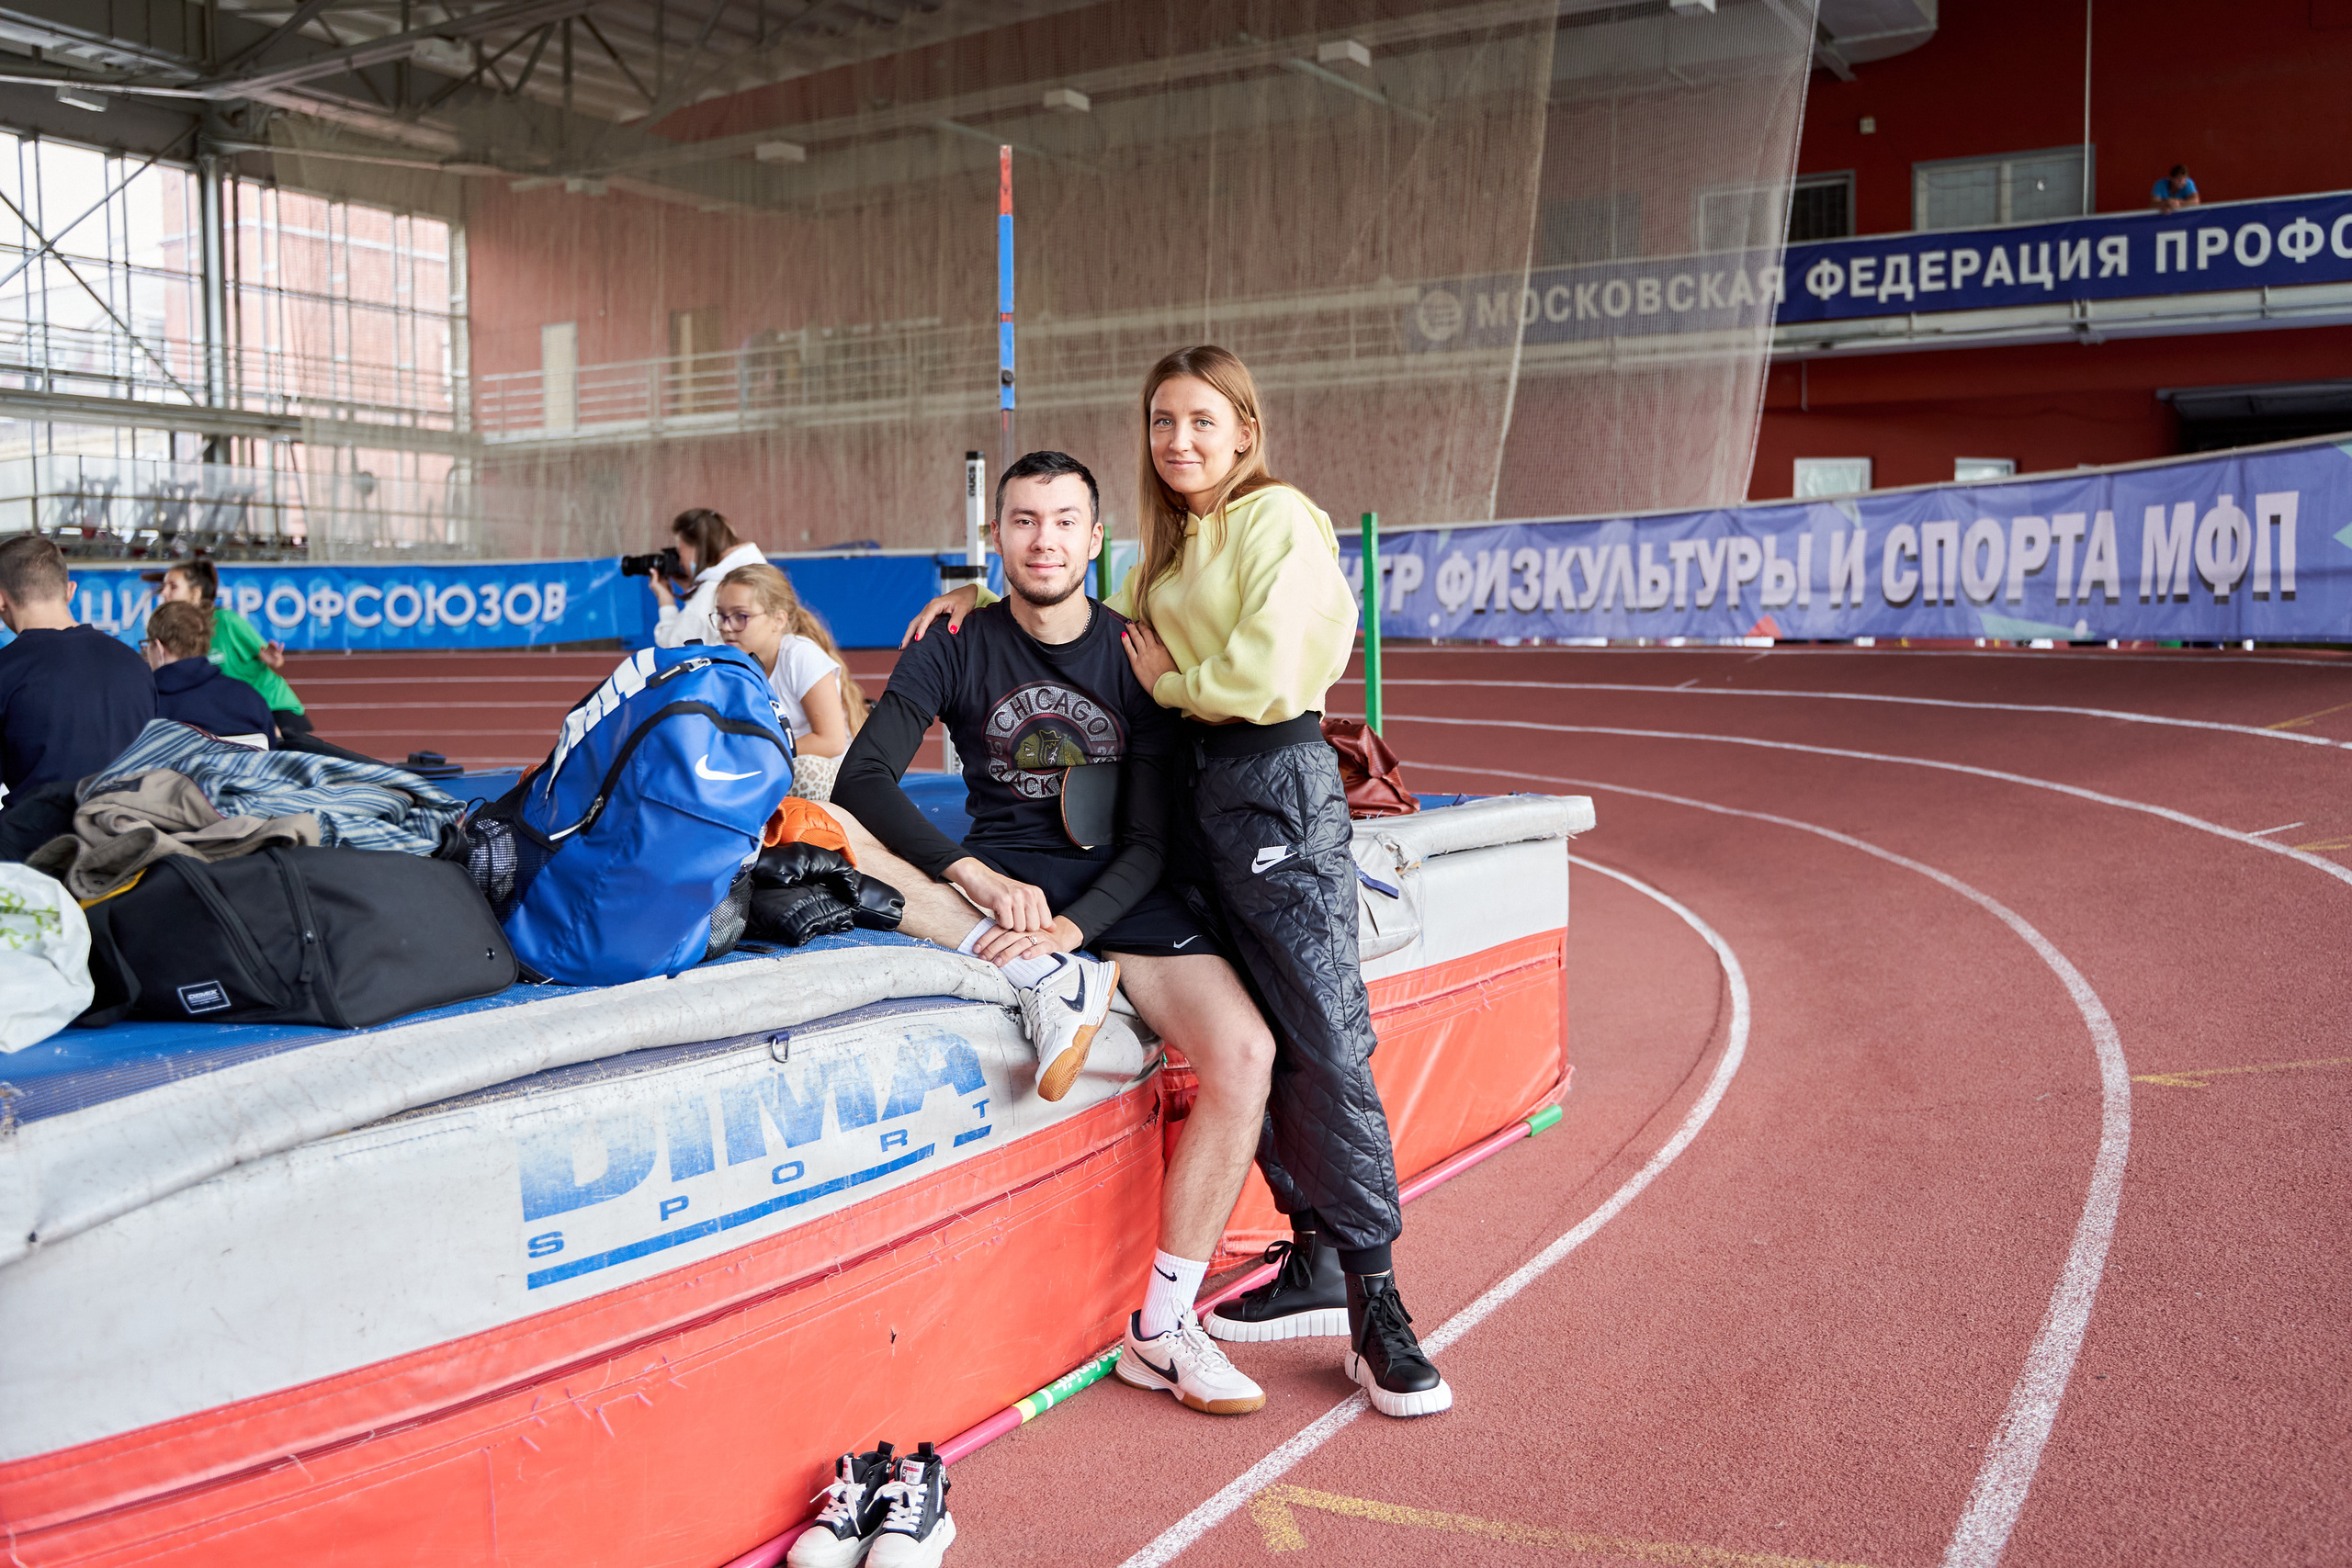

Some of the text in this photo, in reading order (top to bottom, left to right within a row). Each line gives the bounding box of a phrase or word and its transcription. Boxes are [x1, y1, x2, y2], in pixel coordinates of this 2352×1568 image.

[1476, 265, 1787, 328] МОСКОВСКАЯ
[1805, 234, 2129, 303] ФЕДЕРАЦИЯ
[1435, 532, 1813, 615] ФИЗКУЛЬТУРЫ
[1828, 528, 1868, 609] И
[1882, 510, 2121, 607] СПОРТА
[2139, 491, 2299, 604] МФП
[988, 739, 1003, 756] 19
[994, 688, 1109, 735] CHICAGO
[990, 764, 1063, 796] BLACK
[516, 1032, 987, 1223] DIMA
[527, 1099, 991, 1258] SPORT
